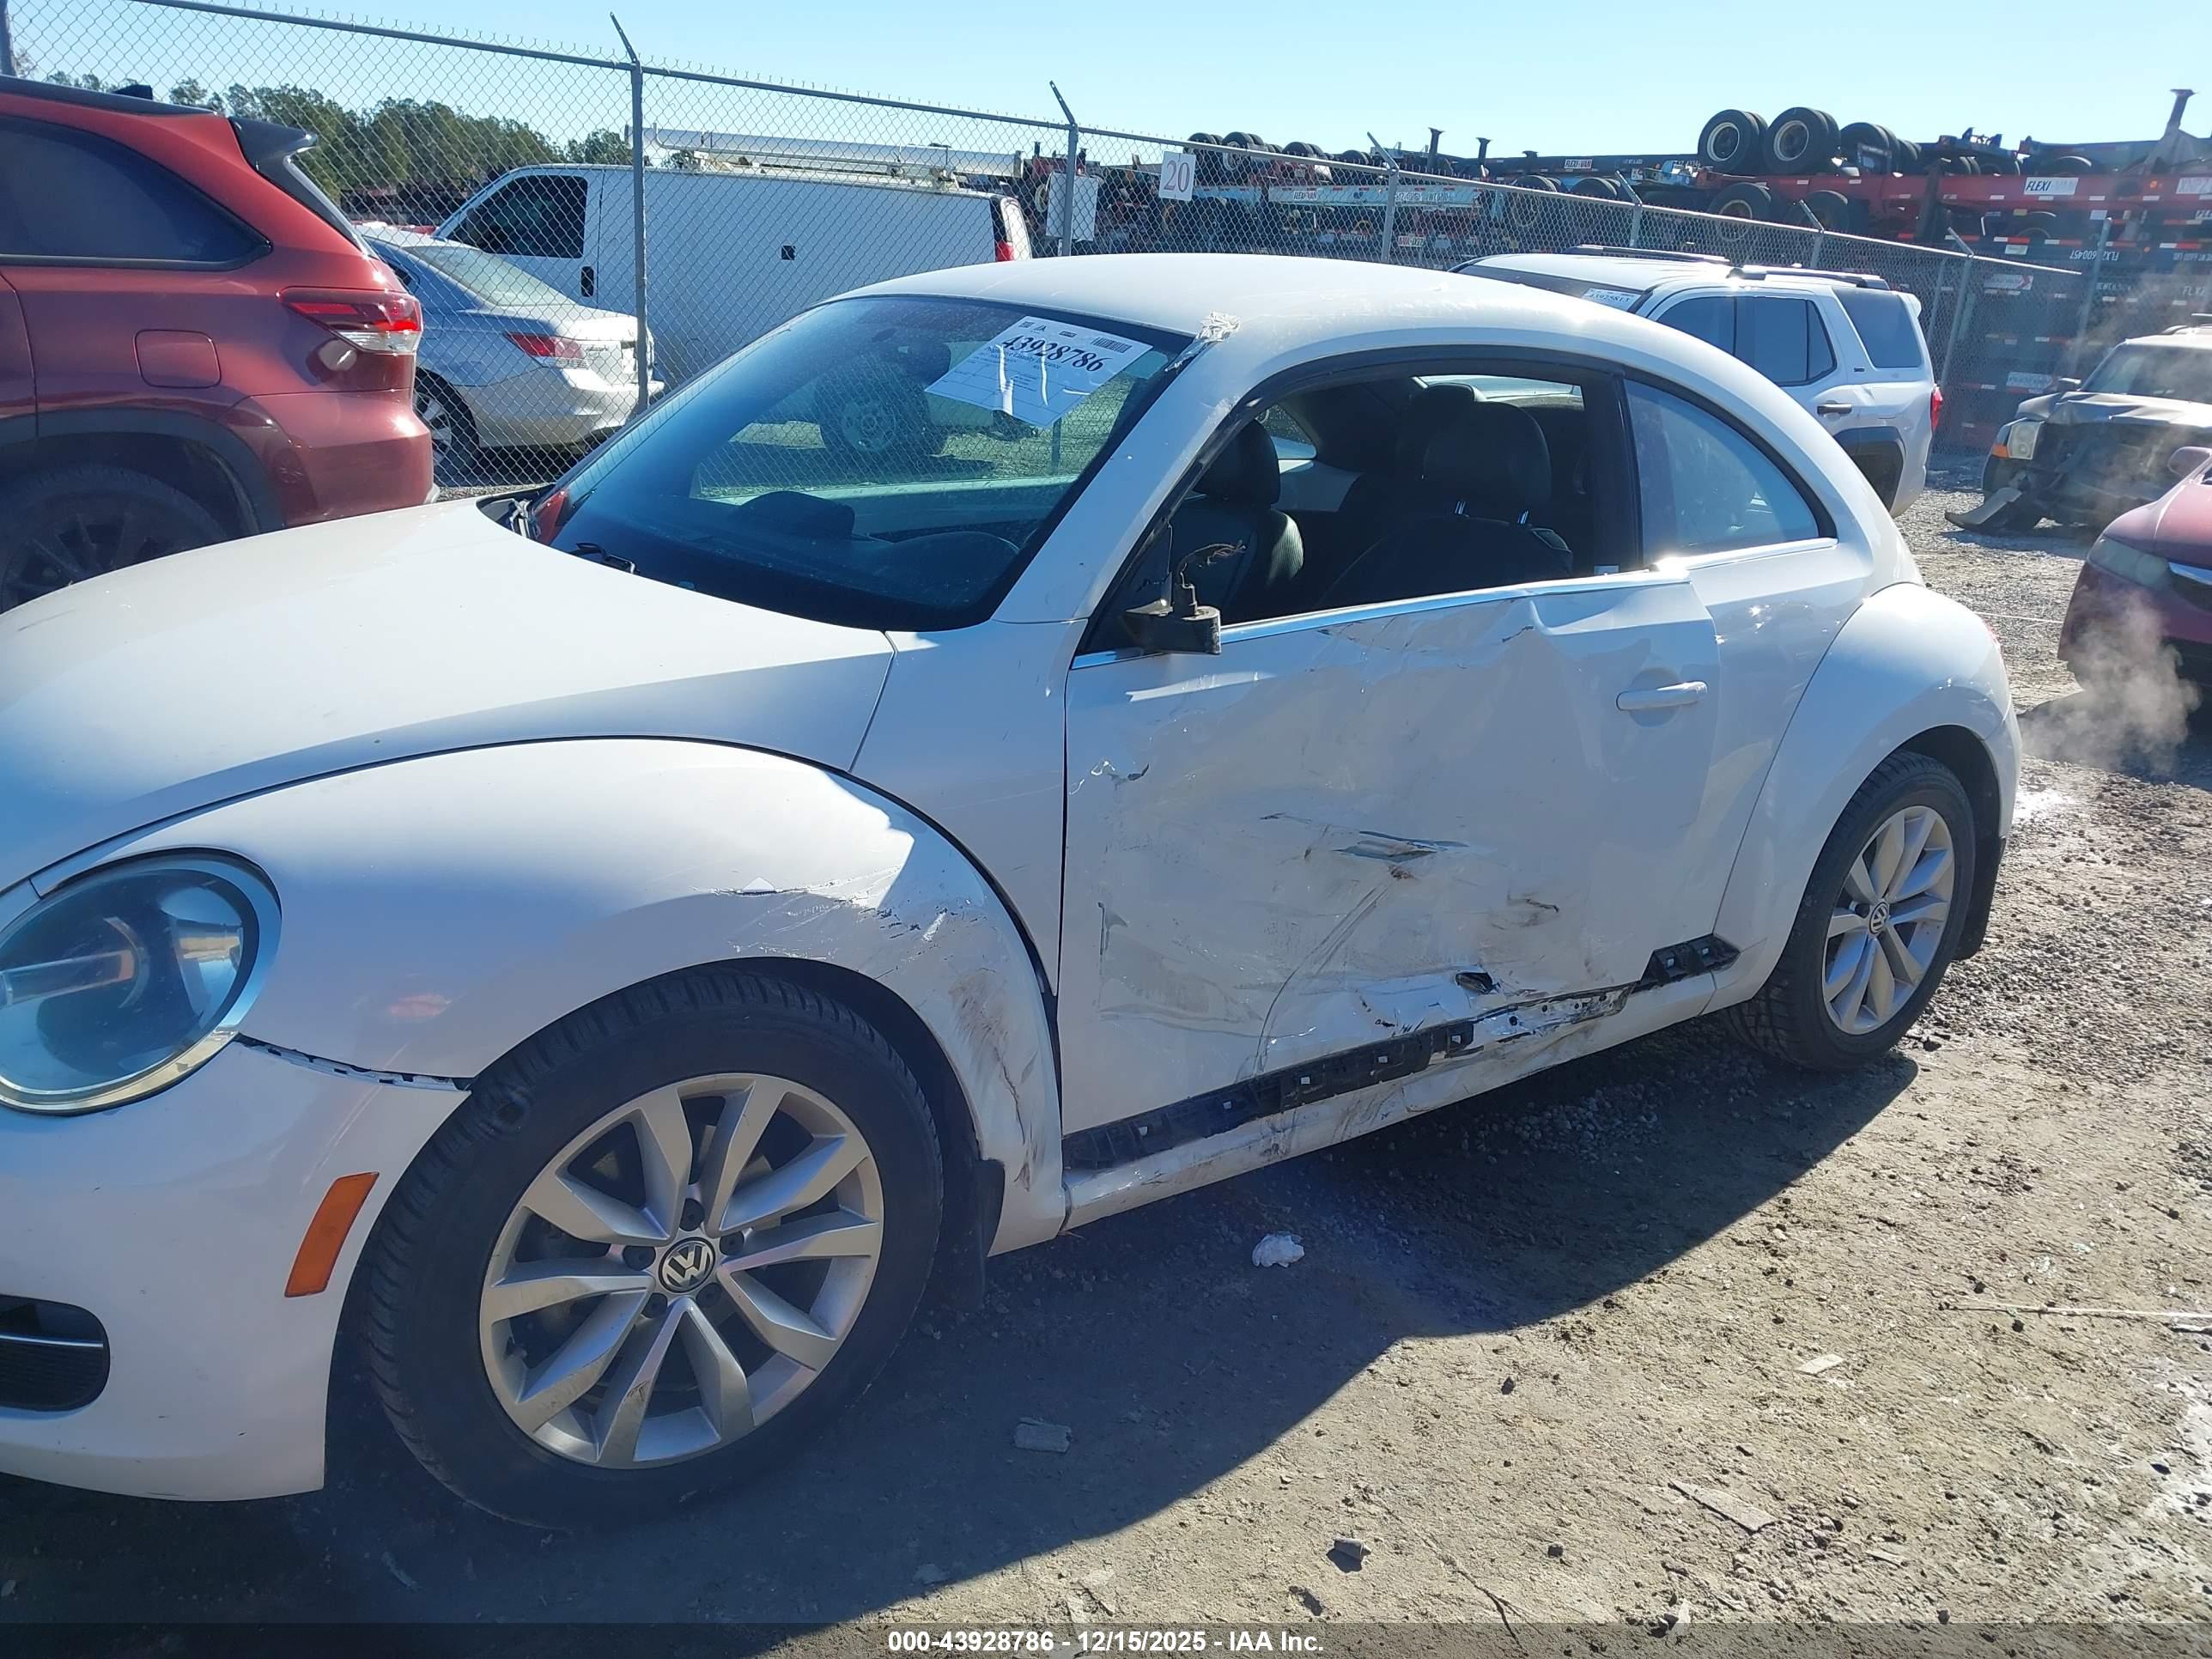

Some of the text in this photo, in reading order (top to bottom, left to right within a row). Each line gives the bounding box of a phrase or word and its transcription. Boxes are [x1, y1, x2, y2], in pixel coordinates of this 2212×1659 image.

[1164, 160, 1190, 193] 20
[2026, 180, 2051, 191] FLEXI
[2069, 249, 2097, 261] 600457
[1002, 335, 1113, 372] 43928786
